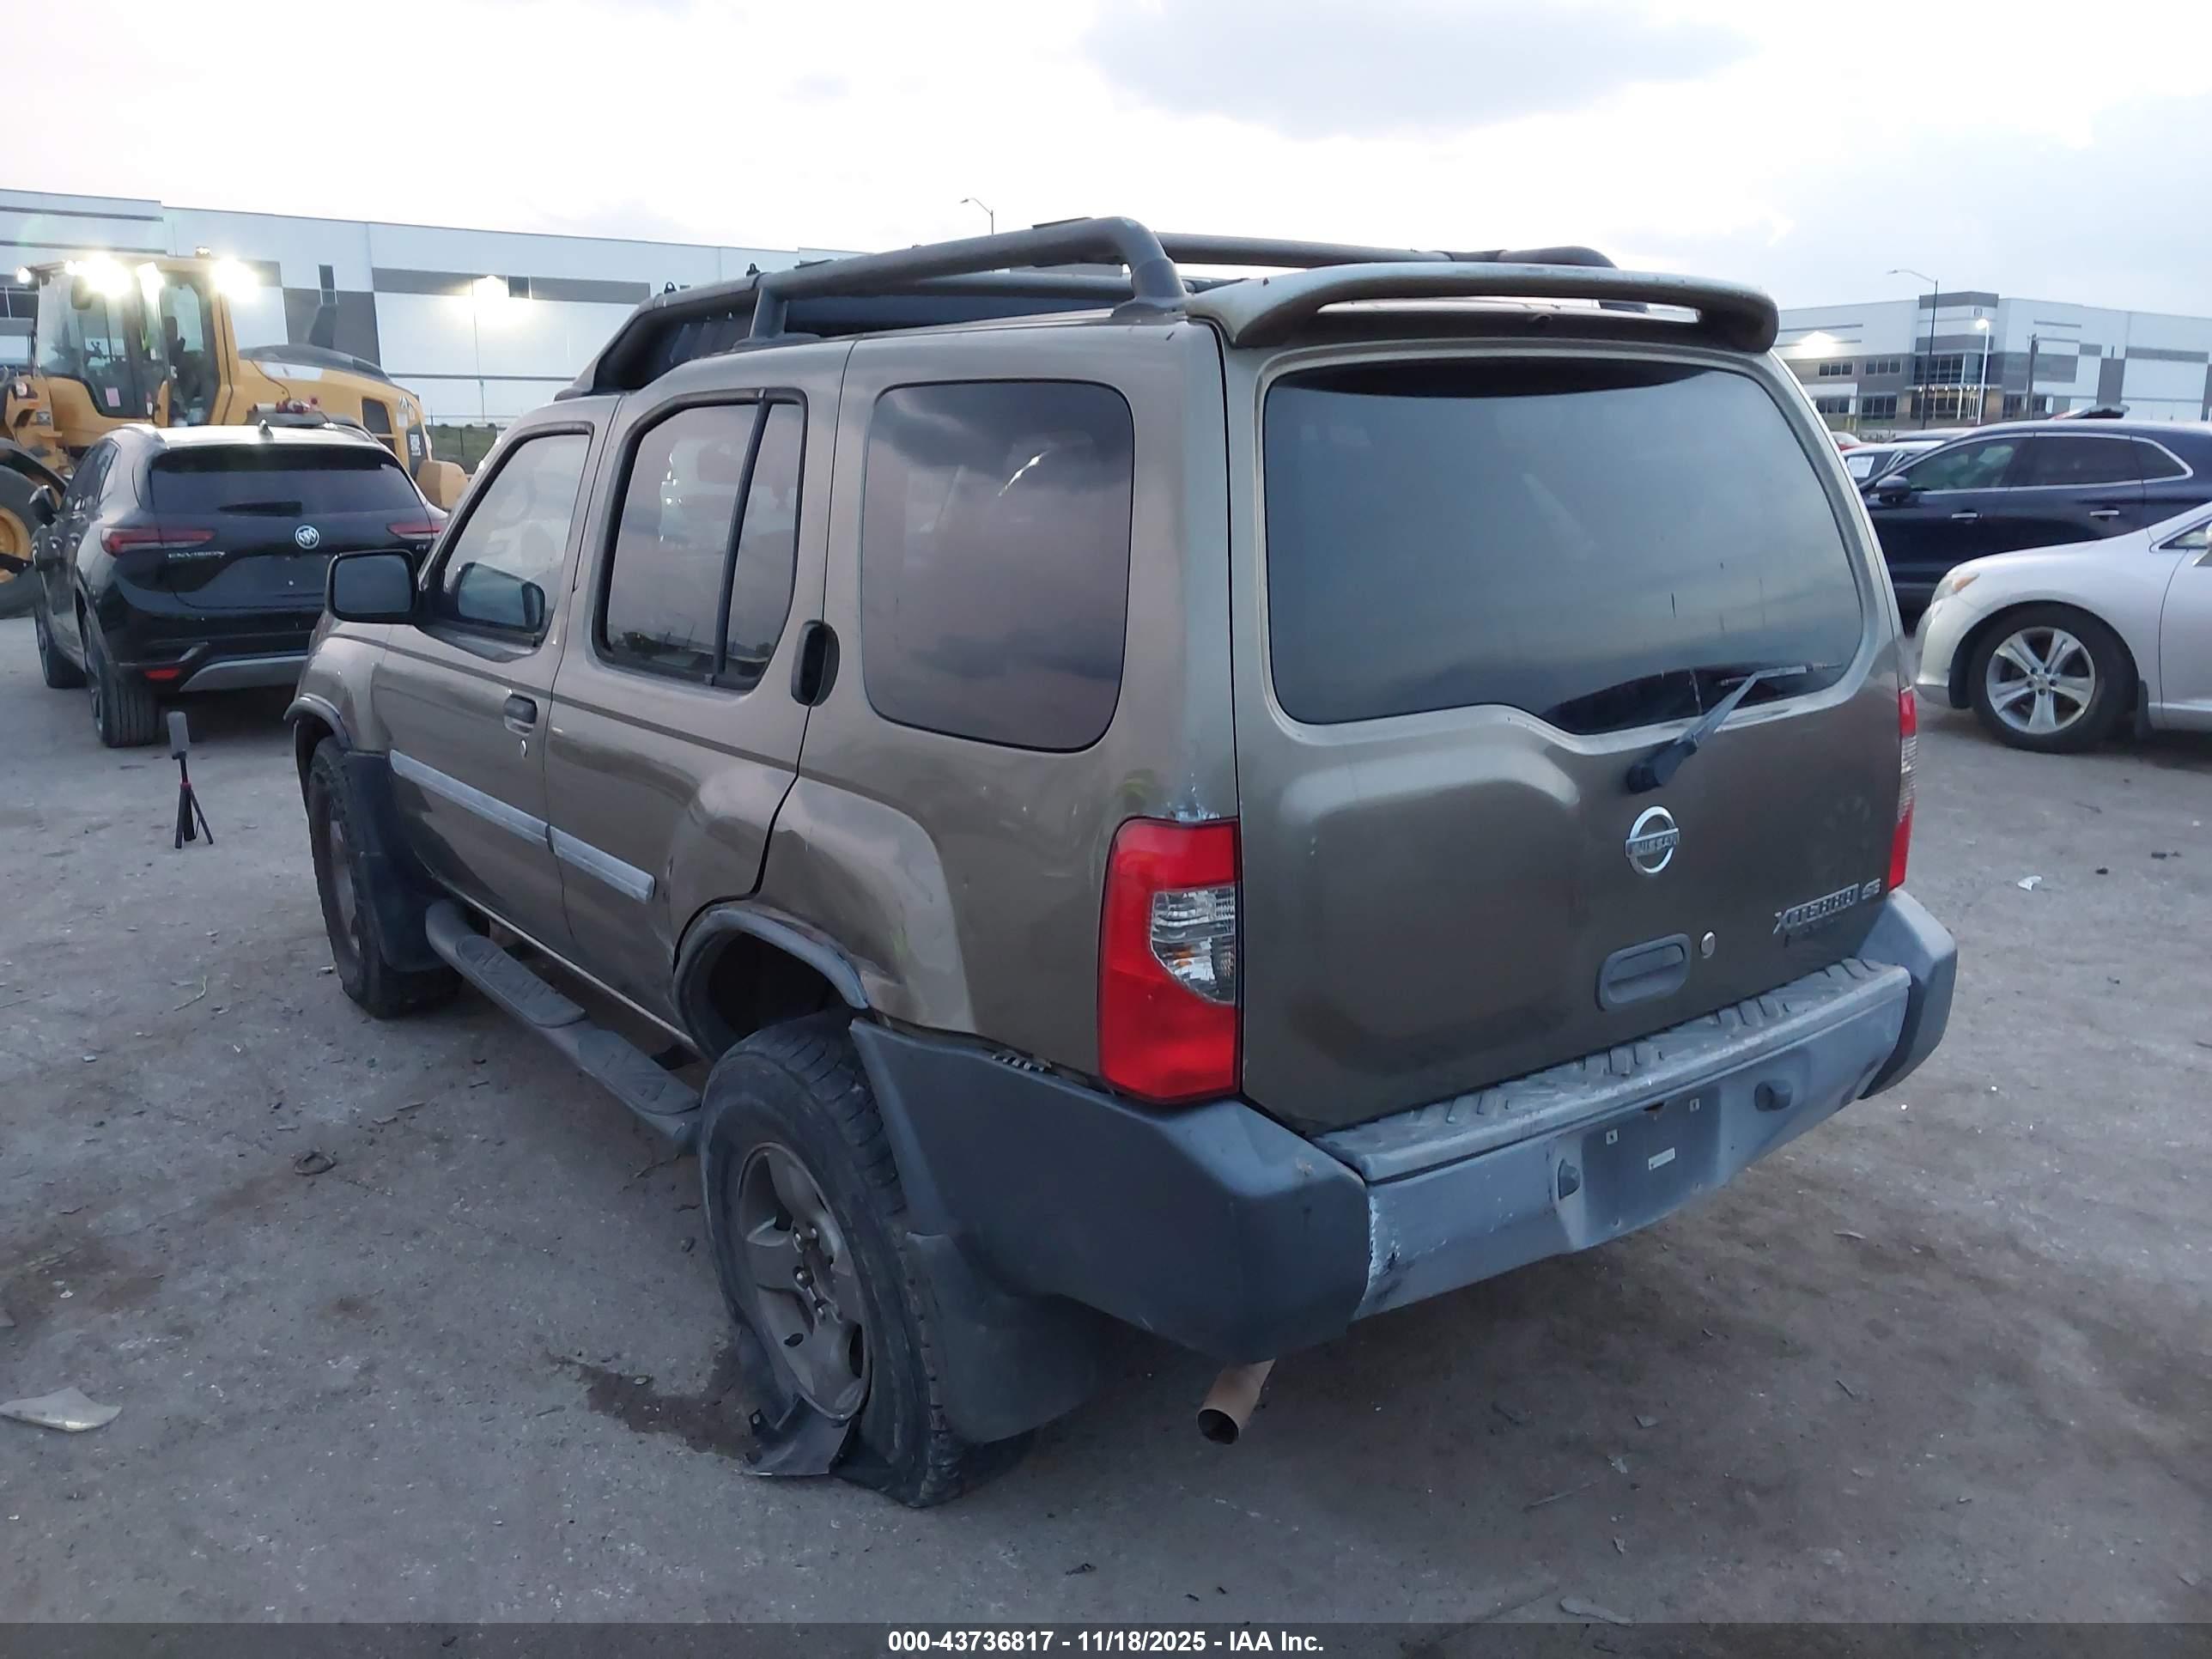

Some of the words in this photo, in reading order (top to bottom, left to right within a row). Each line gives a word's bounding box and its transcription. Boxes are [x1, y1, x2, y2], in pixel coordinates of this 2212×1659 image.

[1632, 832, 1677, 854] NISSAN
[1772, 883, 1859, 934] XTERRA
[1861, 878, 1881, 900] SE
